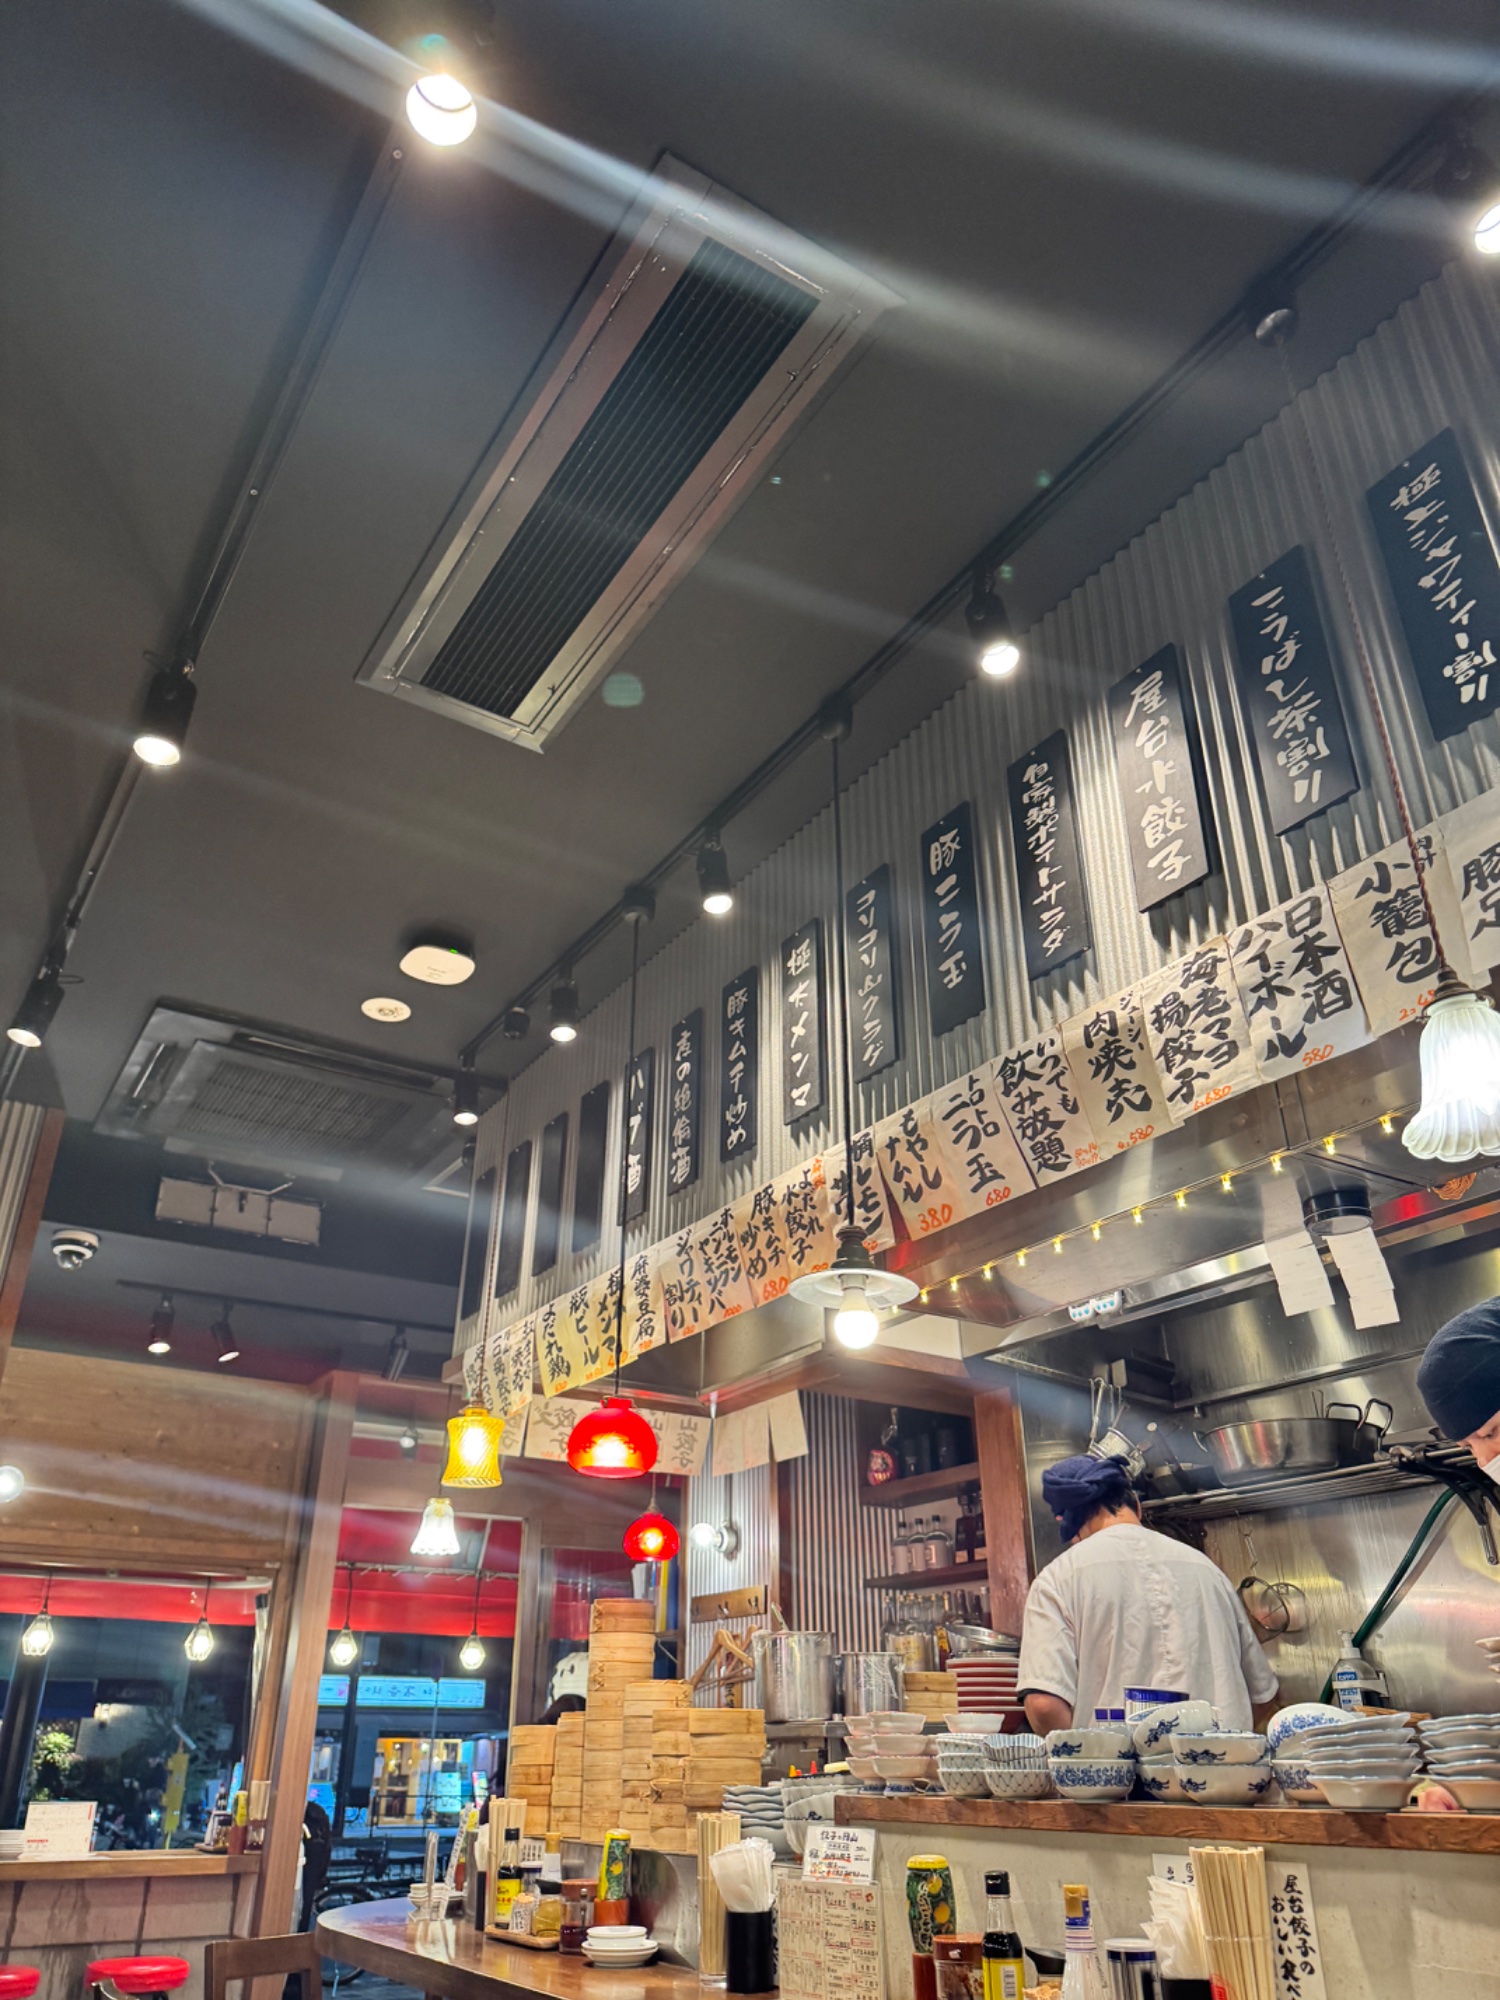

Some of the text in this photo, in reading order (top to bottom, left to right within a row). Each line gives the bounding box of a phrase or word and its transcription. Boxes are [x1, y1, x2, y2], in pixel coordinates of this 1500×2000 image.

[1125, 670, 1192, 882] 屋台水餃子
[929, 827, 968, 989] 豚ニラ玉
[1231, 920, 1308, 1062] ハイボール
[1284, 896, 1355, 1025] 日本酒
[1151, 991, 1211, 1104] 揚餃子
[1180, 947, 1240, 1070] 海老マヨ
[726, 986, 748, 1151] 豚キムチ炒め
[1036, 1037, 1080, 1115] いつでも
[1083, 1010, 1153, 1126] 肉焼売
[1301, 1044, 1334, 1068] 580
[900, 1108, 943, 1190] もやし
[941, 1093, 1007, 1193] ニラ玉
[996, 1048, 1073, 1174] 飲み放題
[751, 1183, 786, 1267] 豚キムチ
[781, 1182, 813, 1266] 水餃子
[799, 1168, 825, 1238] よだれ
[917, 1203, 953, 1232] 380
[985, 1186, 1011, 1207] 680
[698, 1237, 728, 1315] ヤキソバ
[720, 1207, 743, 1283] ホルモン
[740, 1222, 768, 1280] 炒め
[762, 1275, 790, 1301] 680
[630, 1254, 657, 1345] 麻婆豆腐
[1271, 1894, 1302, 2000] おいしい食べ
[1283, 1873, 1317, 1976] 屋台餃子の
